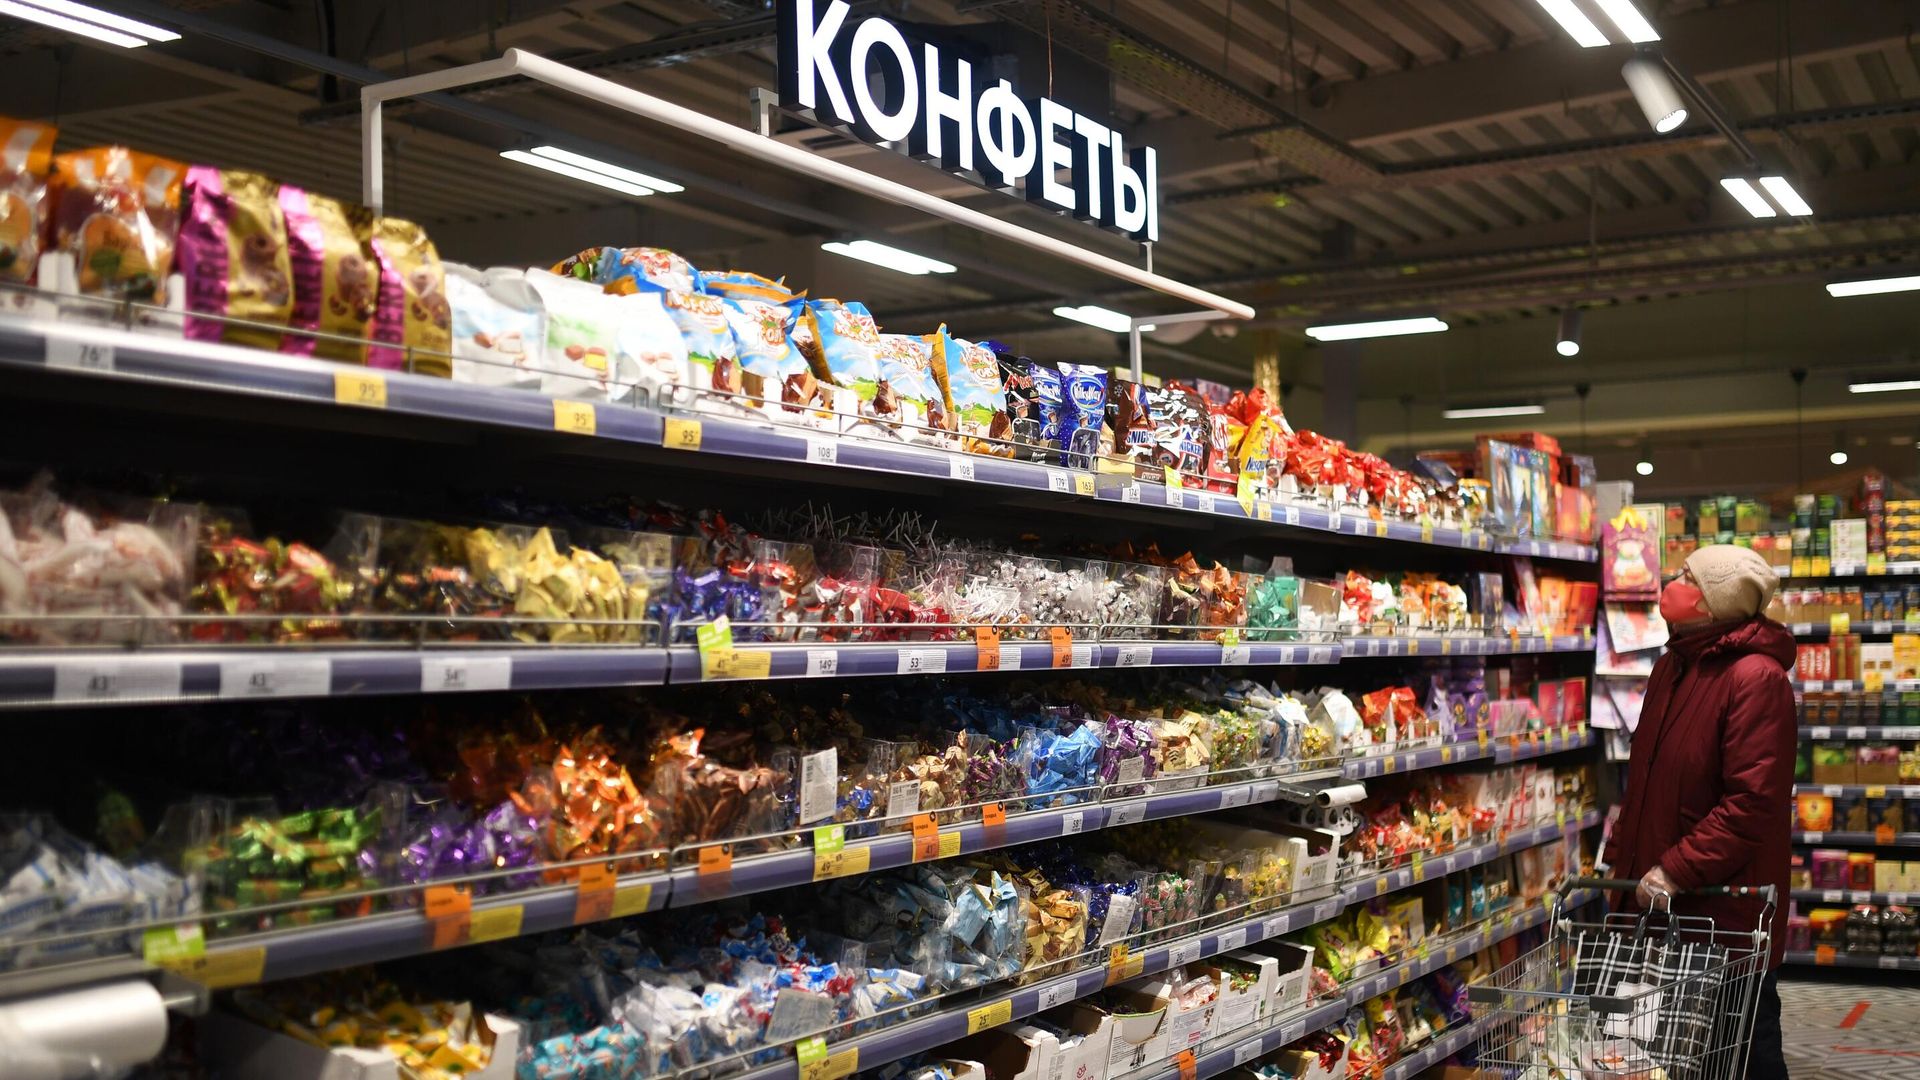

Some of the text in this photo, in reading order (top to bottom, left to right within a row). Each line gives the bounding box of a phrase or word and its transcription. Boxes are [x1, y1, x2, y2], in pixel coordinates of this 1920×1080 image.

[797, 0, 1159, 242] КОНФЕТЫ
[682, 430, 694, 443] 95
[910, 657, 919, 668] 53
[989, 655, 996, 665] 31
[1061, 654, 1069, 663] 49
[820, 660, 831, 670] 149
[979, 1014, 987, 1025] 25
